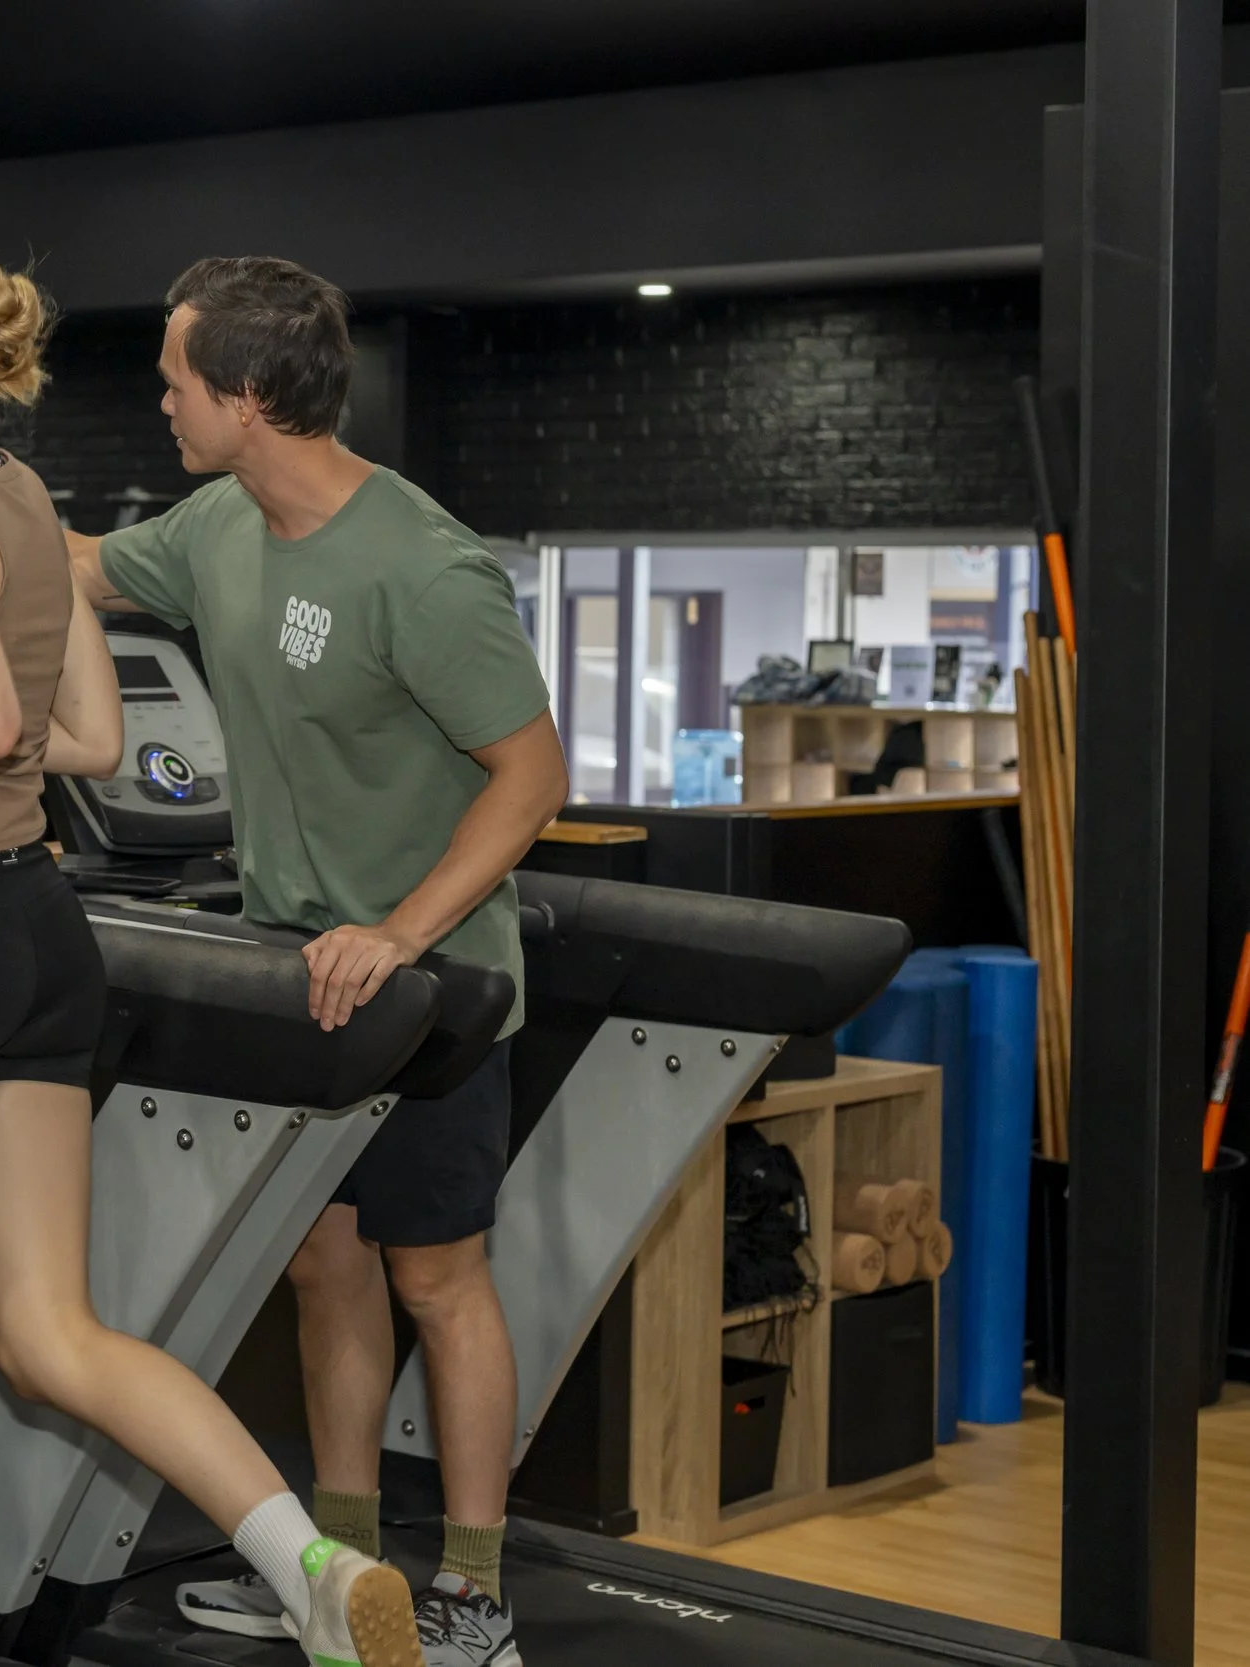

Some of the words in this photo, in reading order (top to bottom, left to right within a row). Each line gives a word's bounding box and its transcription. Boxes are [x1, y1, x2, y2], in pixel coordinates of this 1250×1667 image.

[285, 595, 332, 637] GOOD
[278, 622, 326, 664] VIBES
[285, 653, 308, 671] PHYSIO
